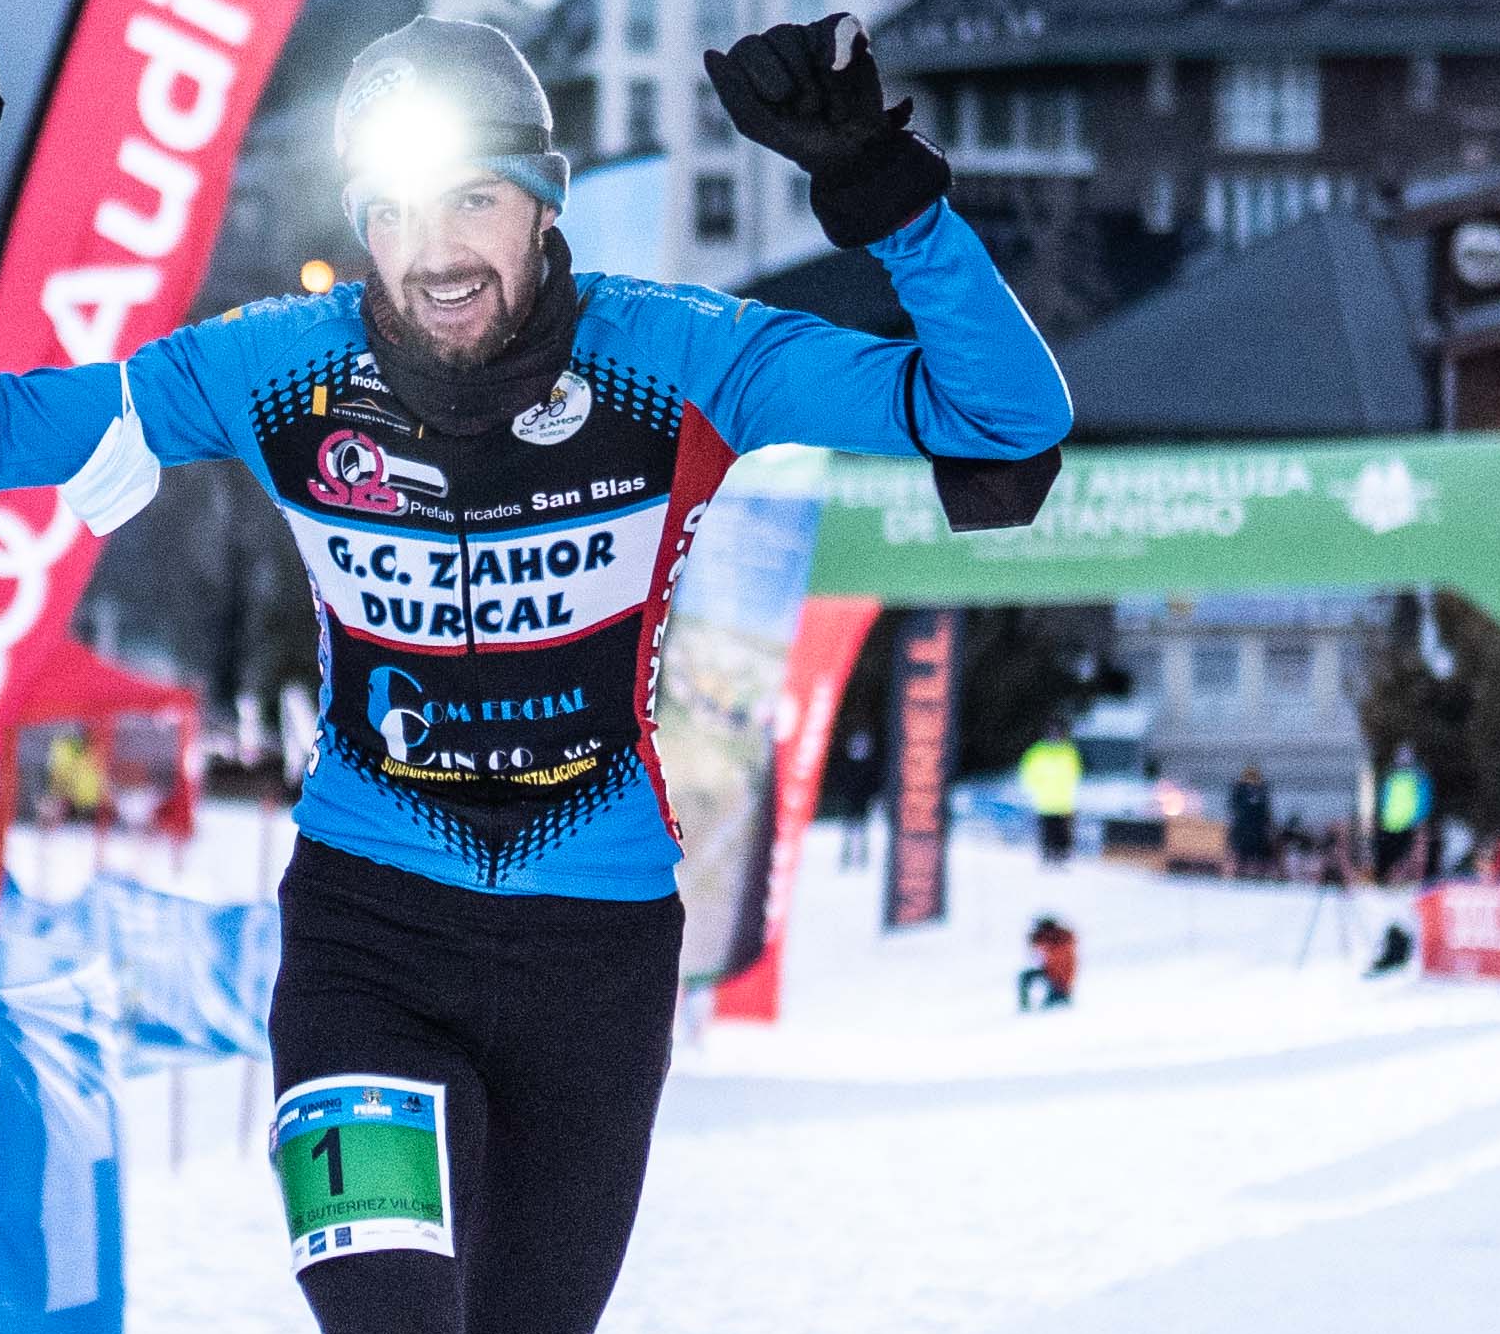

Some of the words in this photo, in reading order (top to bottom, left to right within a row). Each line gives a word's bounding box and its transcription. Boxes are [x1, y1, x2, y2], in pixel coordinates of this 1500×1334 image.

[531, 490, 581, 512] San
[590, 475, 647, 500] Blas
[328, 534, 411, 586] G.C.
[429, 530, 617, 590] ZAHOR
[361, 591, 573, 639] DURCAL
[311, 1126, 345, 1197] 1
[307, 1198, 386, 1222] GUTIERREZ
